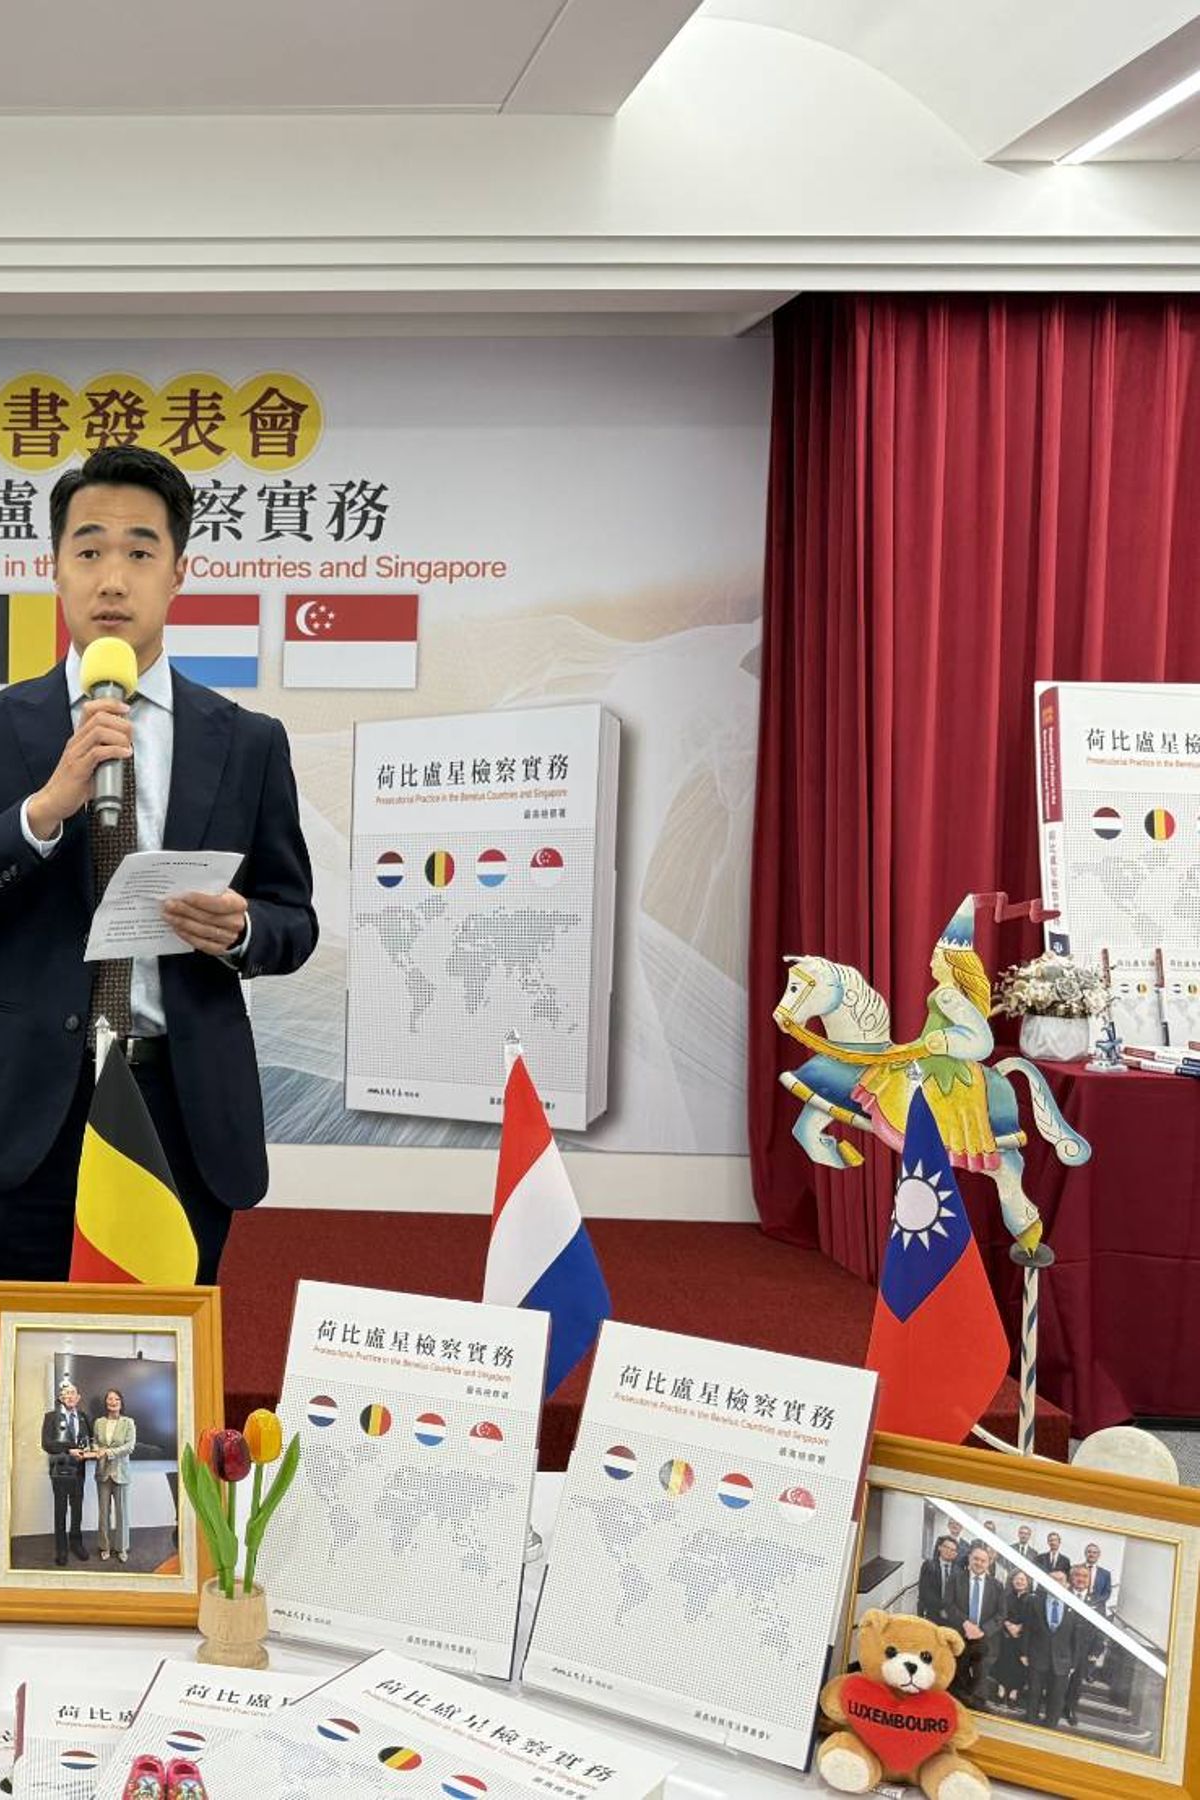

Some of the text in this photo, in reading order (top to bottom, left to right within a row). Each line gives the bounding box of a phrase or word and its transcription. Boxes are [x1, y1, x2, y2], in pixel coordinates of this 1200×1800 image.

[5, 554, 27, 577] in
[34, 555, 58, 577] th
[191, 556, 312, 579] Countries
[319, 556, 369, 580] and
[376, 556, 508, 584] Singapore
[377, 754, 569, 789] 荷比盧星檢察實務
[317, 1320, 515, 1369] 荷比盧星檢察實務
[618, 1365, 836, 1431] 荷比盧星檢察實務
[848, 1700, 949, 1733] LUXEMBOURG
